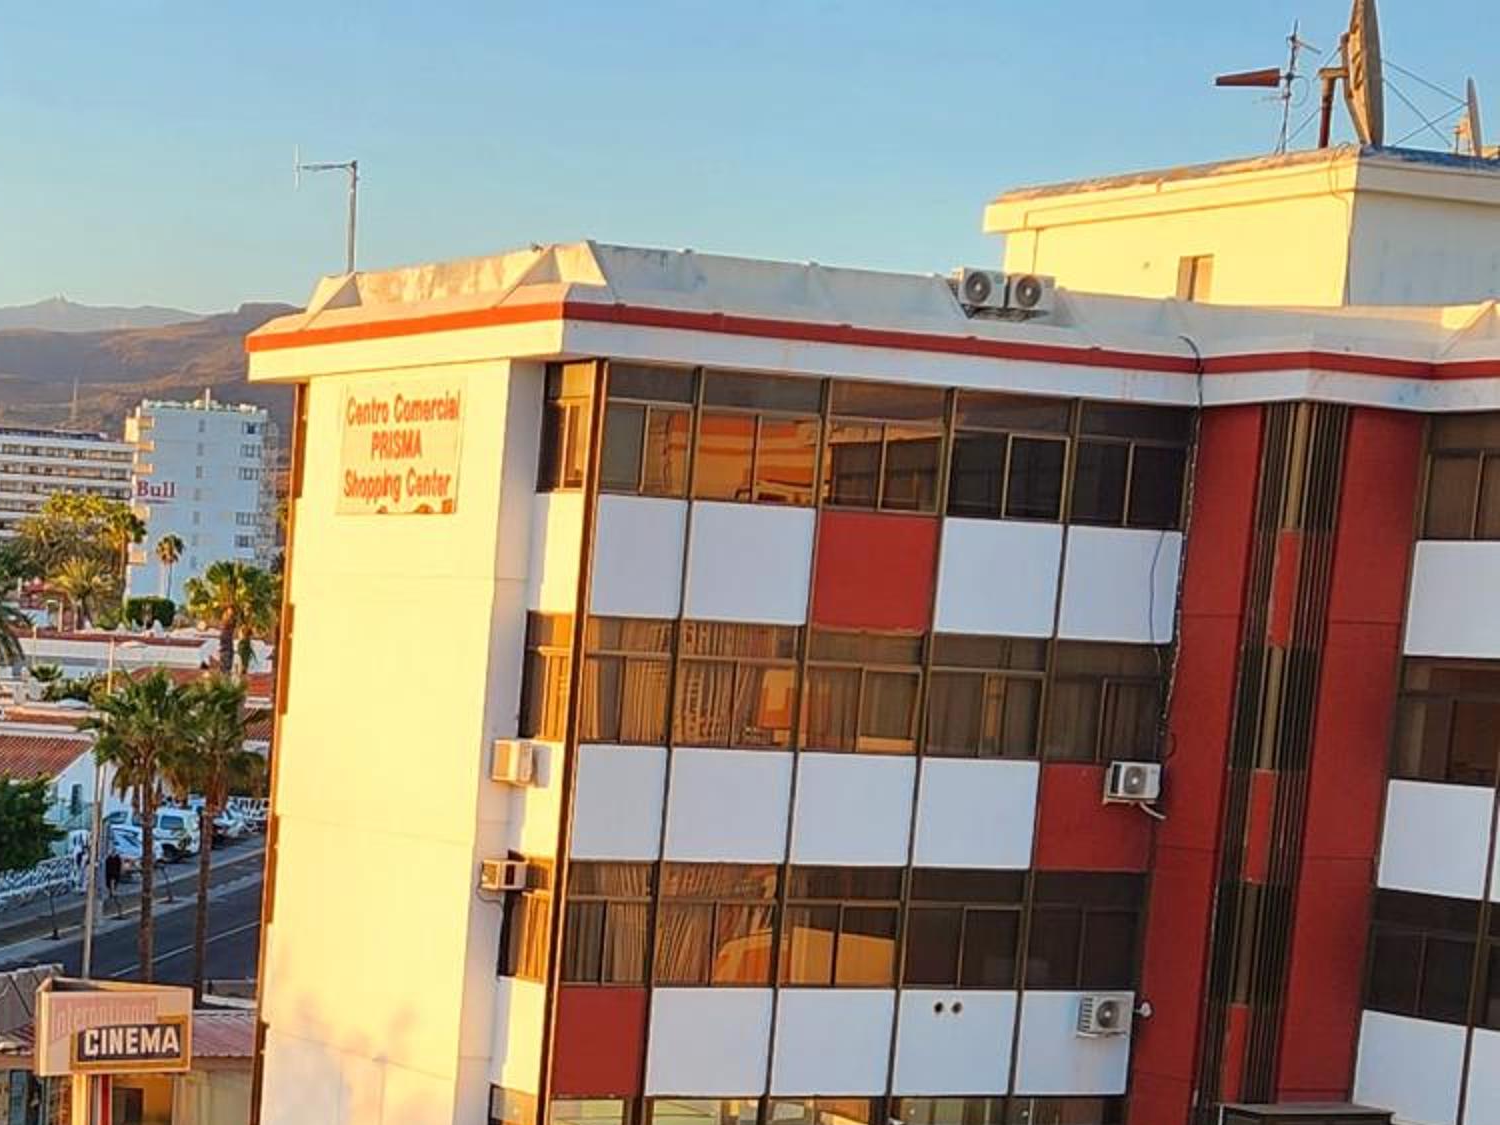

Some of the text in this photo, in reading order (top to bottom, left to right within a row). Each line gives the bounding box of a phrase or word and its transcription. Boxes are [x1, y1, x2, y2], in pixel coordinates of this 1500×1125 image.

[347, 390, 461, 427] Centro Comercial
[371, 429, 423, 460] PRISMA
[136, 480, 176, 498] Bull
[343, 467, 452, 505] Shopping Center
[83, 1026, 180, 1056] CINEMA
